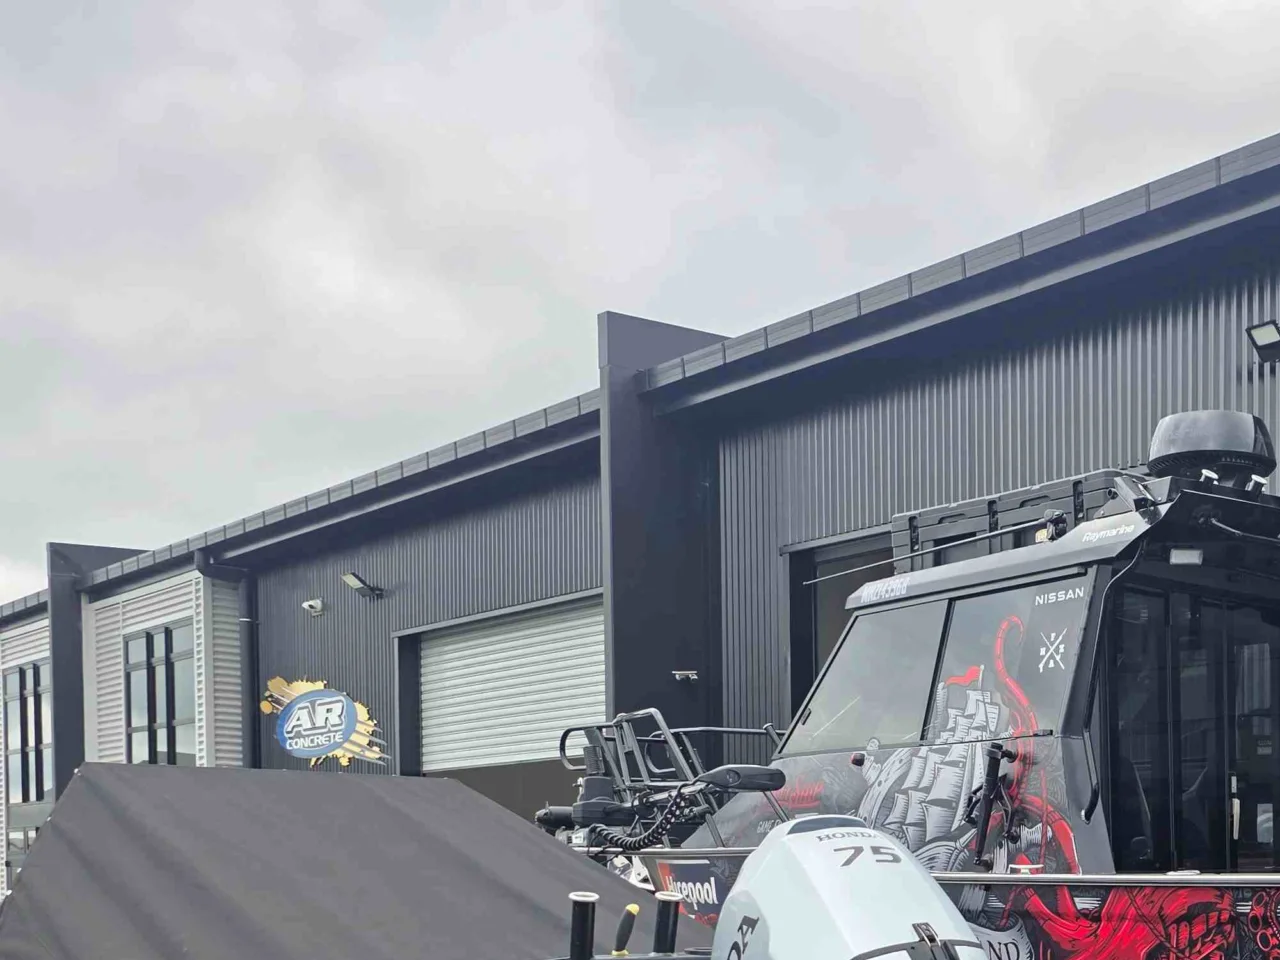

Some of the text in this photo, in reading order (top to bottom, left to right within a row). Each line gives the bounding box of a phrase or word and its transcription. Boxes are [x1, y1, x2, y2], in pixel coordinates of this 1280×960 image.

[1035, 586, 1084, 606] NISSAN
[284, 696, 345, 737] AR
[286, 732, 344, 749] CONCRETE
[833, 845, 902, 867] 75
